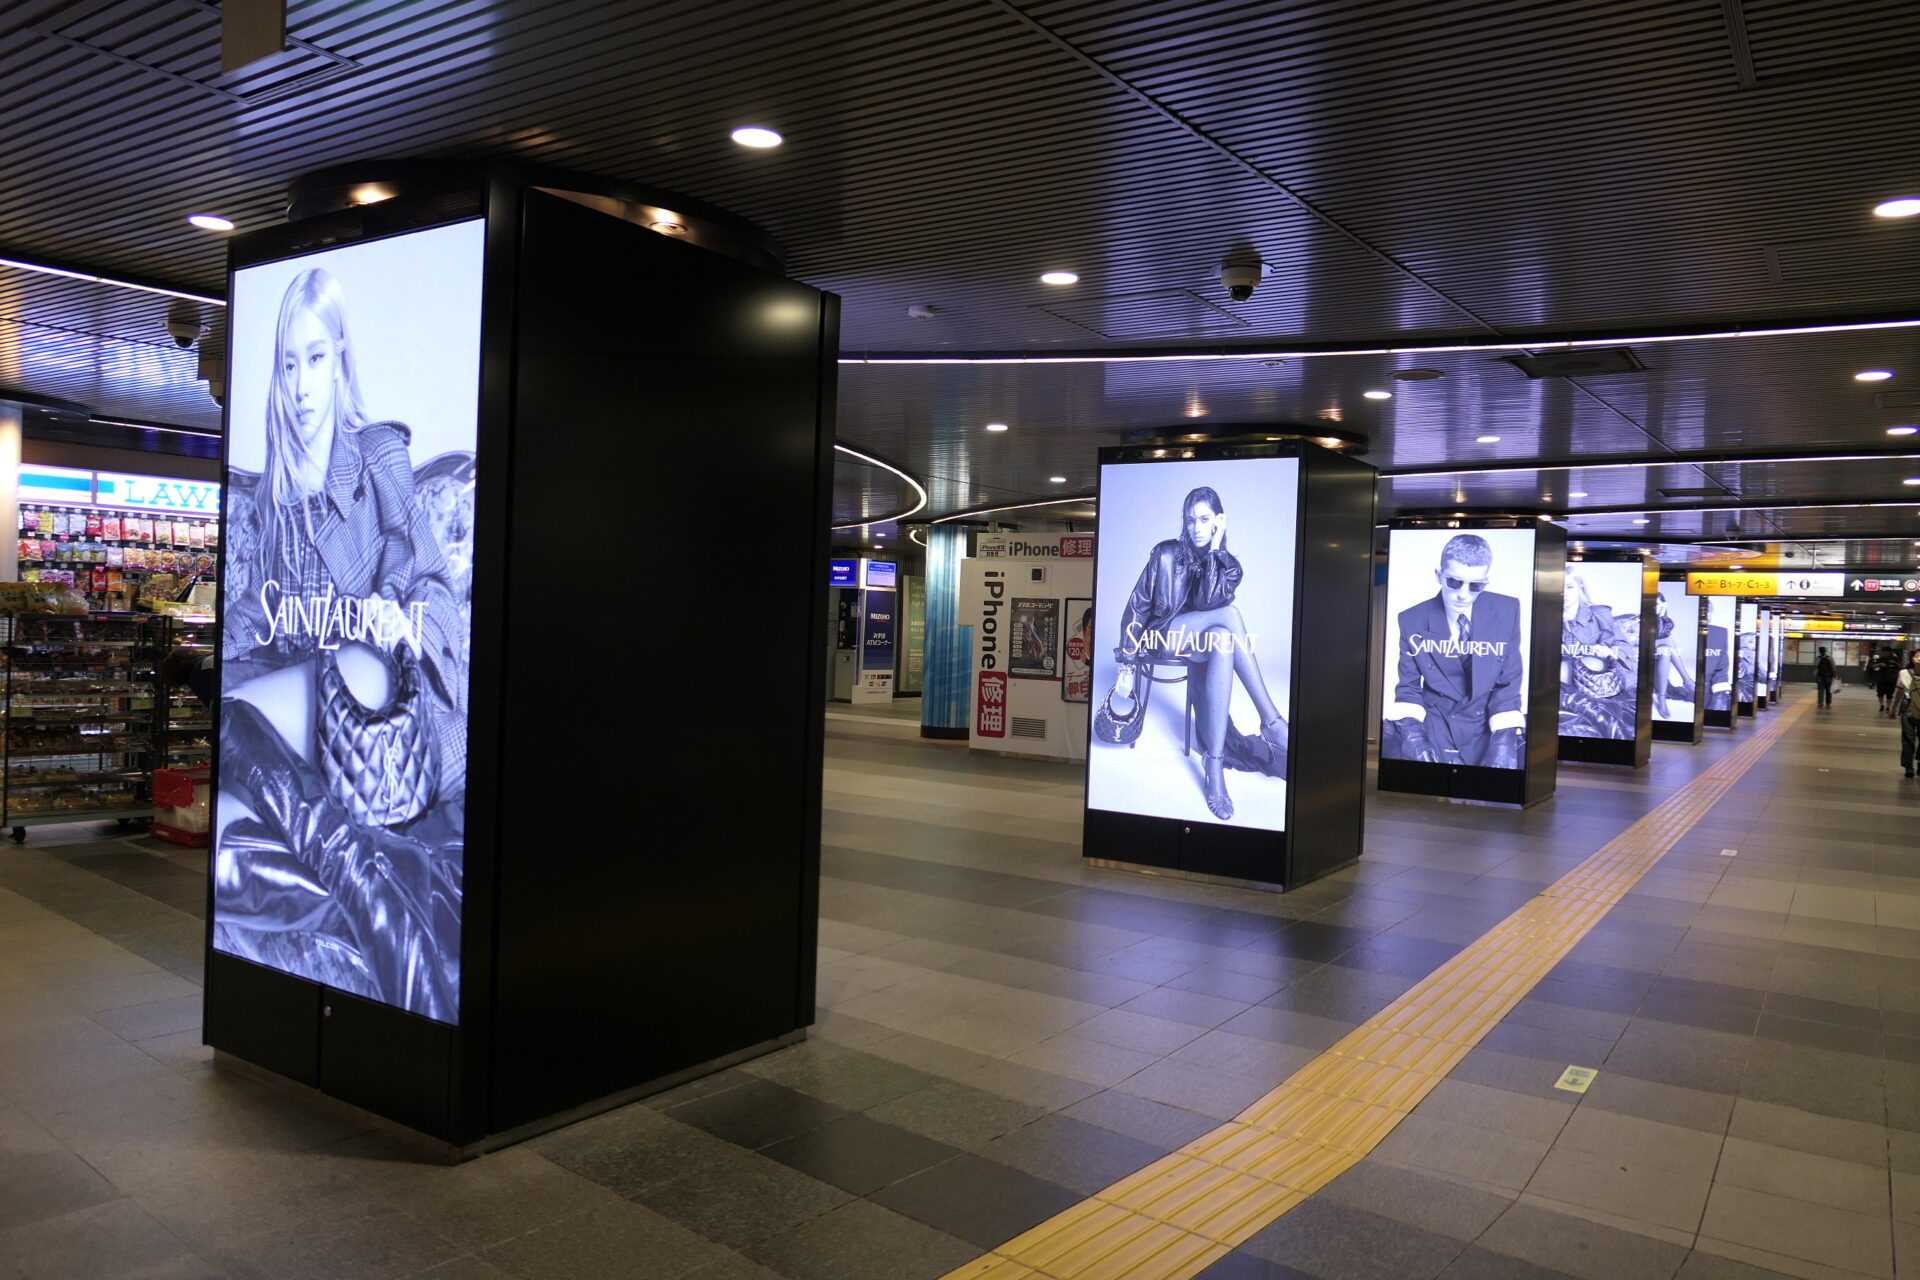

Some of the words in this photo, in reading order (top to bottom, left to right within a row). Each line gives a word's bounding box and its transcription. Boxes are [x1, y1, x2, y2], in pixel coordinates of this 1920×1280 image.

[124, 479, 220, 508] LAW
[1009, 541, 1059, 557] iPhone
[1062, 539, 1092, 556] 修理
[870, 612, 891, 620] MIZUHO
[981, 571, 1005, 670] iPhone
[980, 676, 1003, 732] 修理
